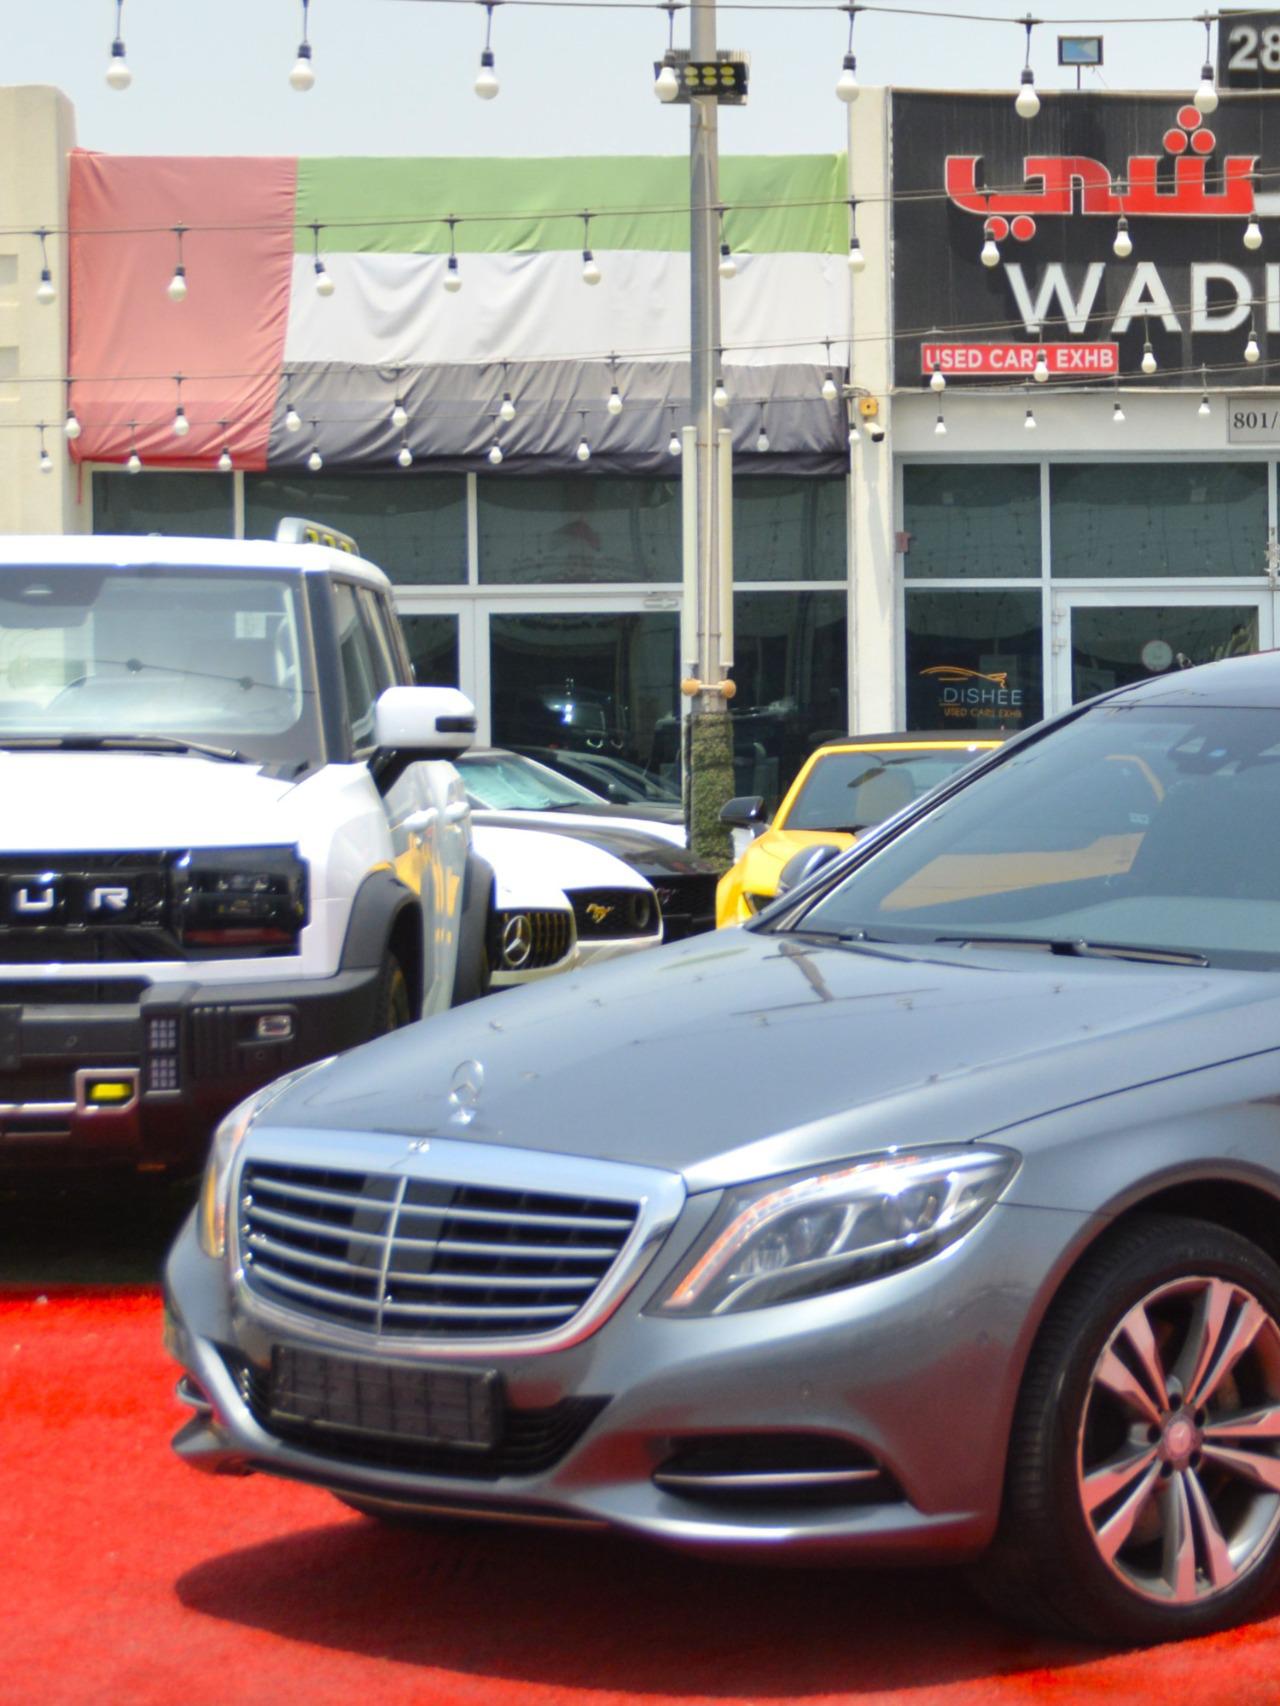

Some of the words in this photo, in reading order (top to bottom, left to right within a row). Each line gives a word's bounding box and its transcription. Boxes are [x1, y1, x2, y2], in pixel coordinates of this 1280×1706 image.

[926, 349, 983, 369] USED
[1056, 349, 1114, 369] EXHB
[943, 687, 1022, 705] DISHEE
